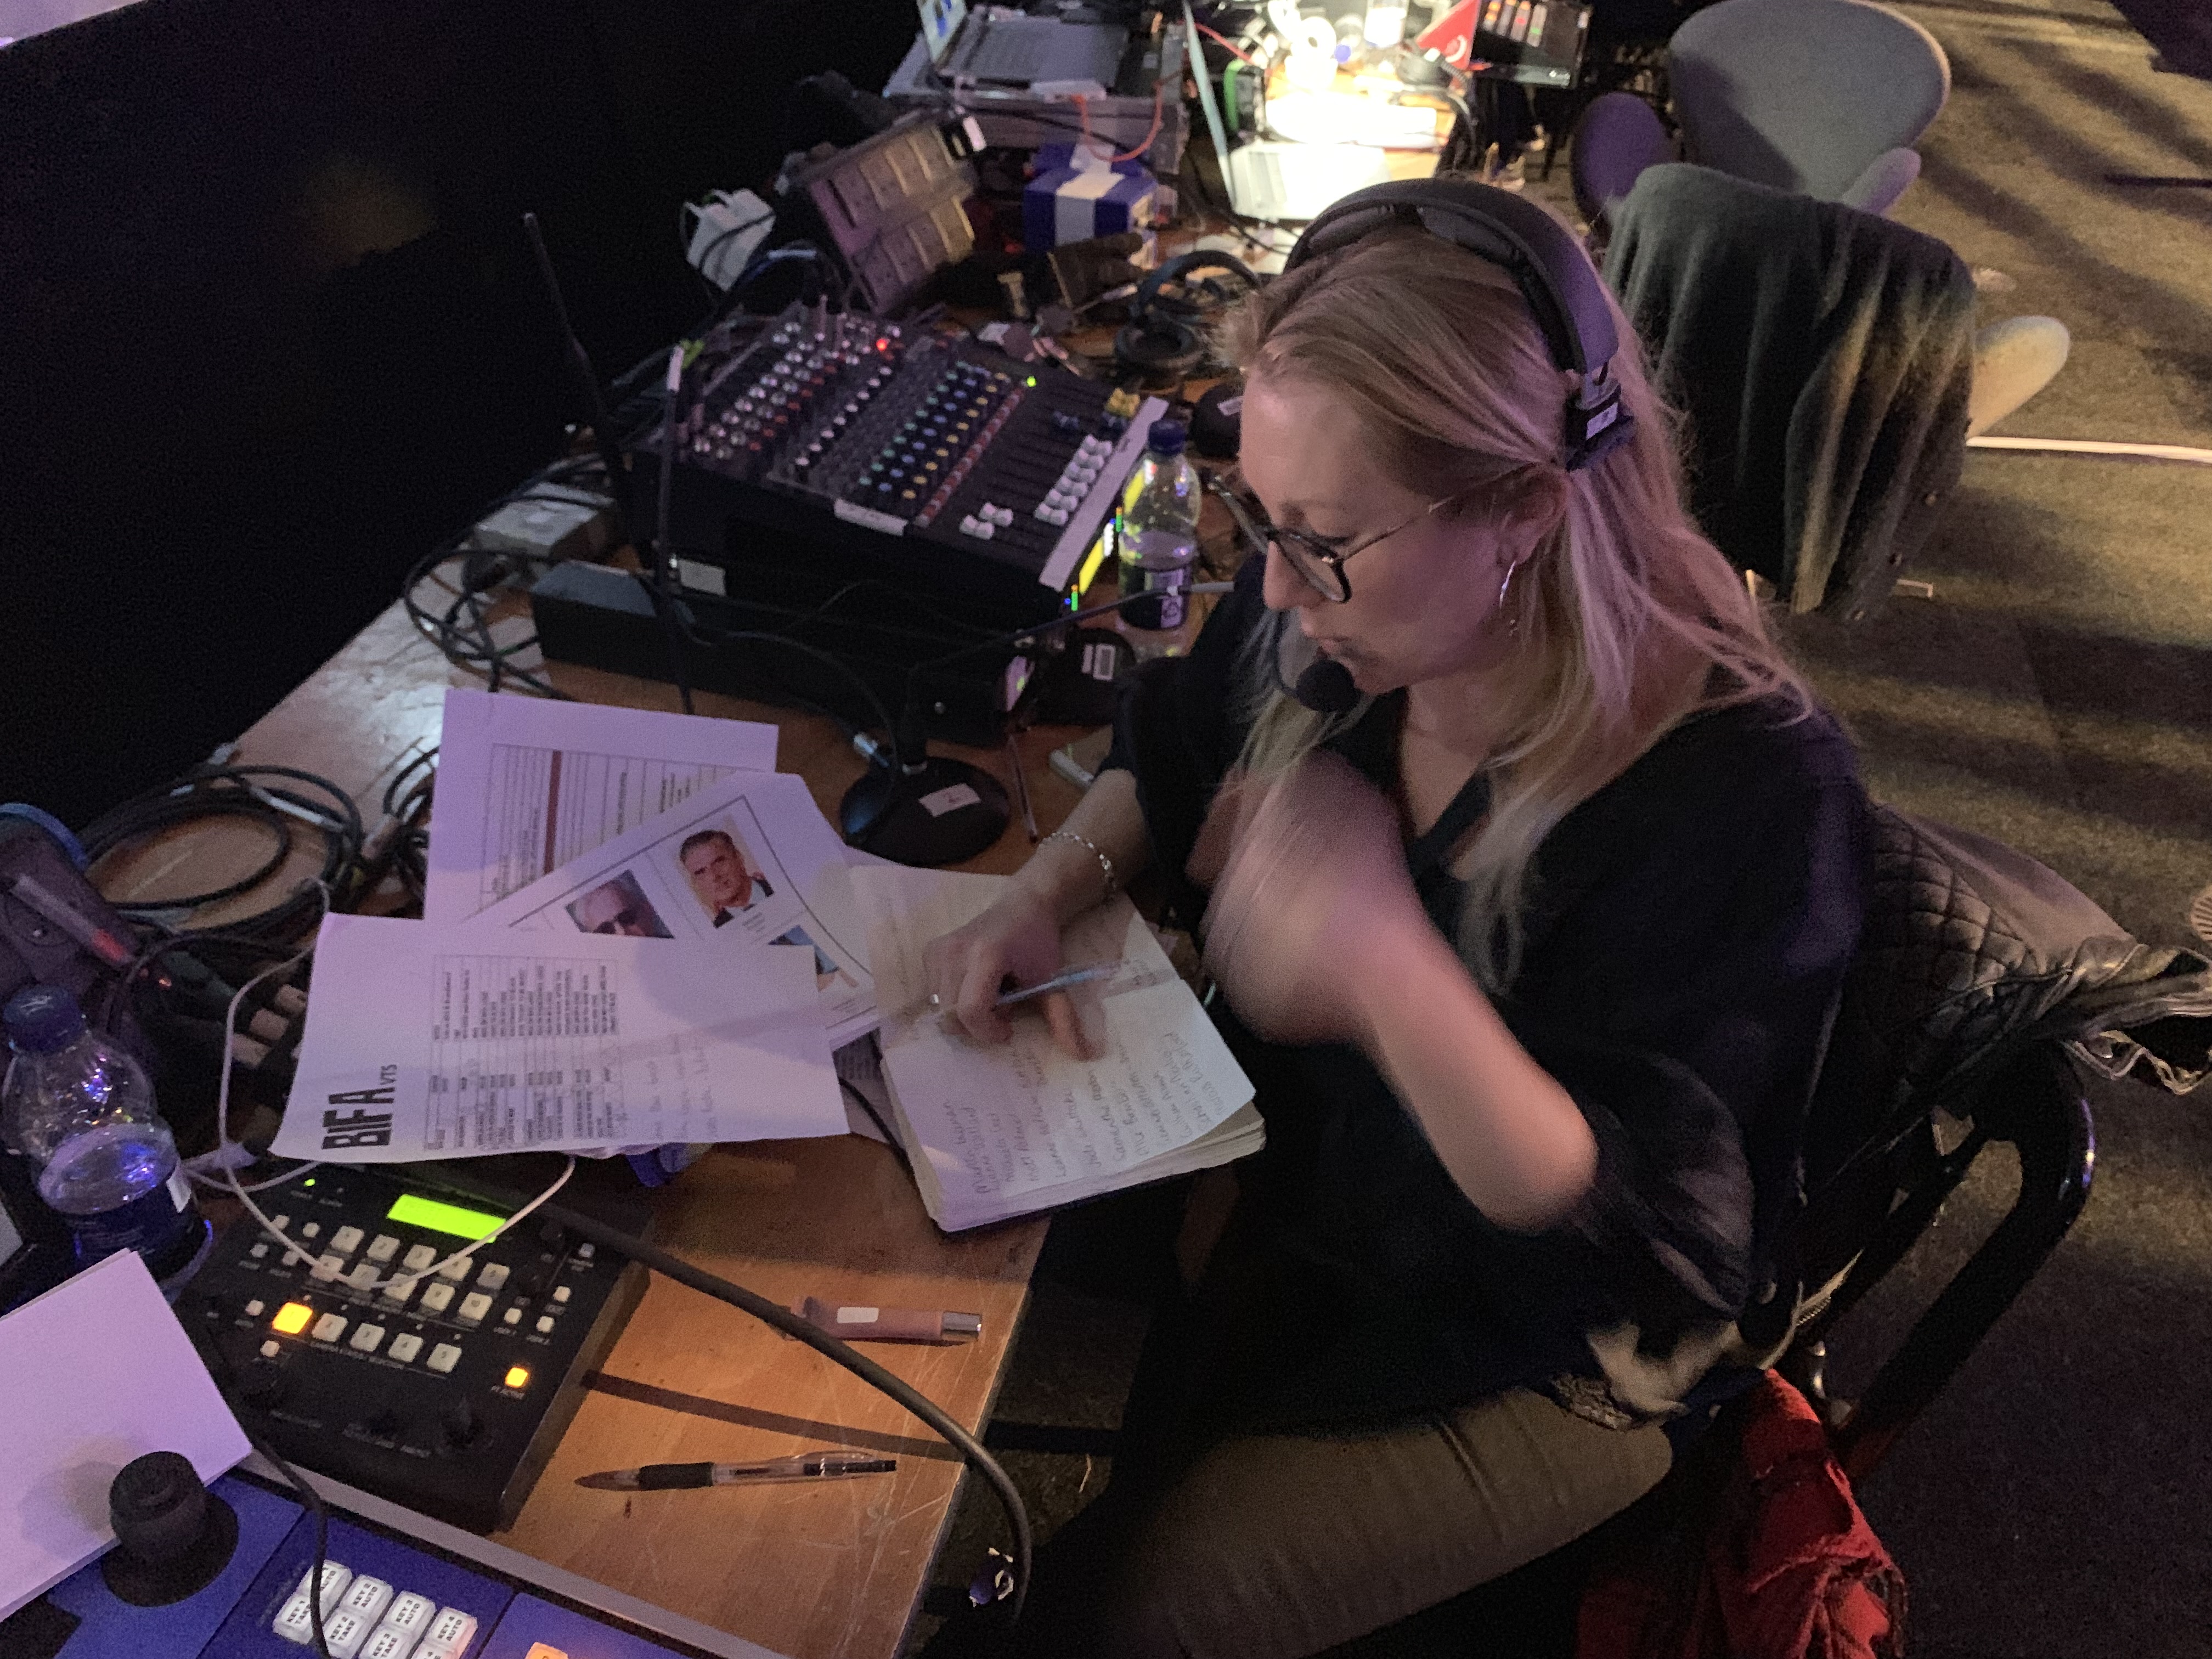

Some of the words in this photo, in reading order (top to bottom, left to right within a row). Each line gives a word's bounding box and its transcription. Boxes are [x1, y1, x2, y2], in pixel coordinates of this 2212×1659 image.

[321, 1087, 395, 1150] BIFA
[380, 1064, 397, 1085] VTS
[353, 1590, 365, 1605] KEY
[361, 1587, 378, 1607] AUTO
[286, 1606, 300, 1623] KEY
[396, 1606, 408, 1622] KEY
[404, 1603, 421, 1624] AUTO
[330, 1623, 342, 1640] KEY
[338, 1620, 356, 1641] TAKE
[438, 1623, 450, 1639] KEY
[446, 1619, 462, 1641] AUTO
[372, 1639, 385, 1656] KEY
[381, 1637, 398, 1658] TAKE
